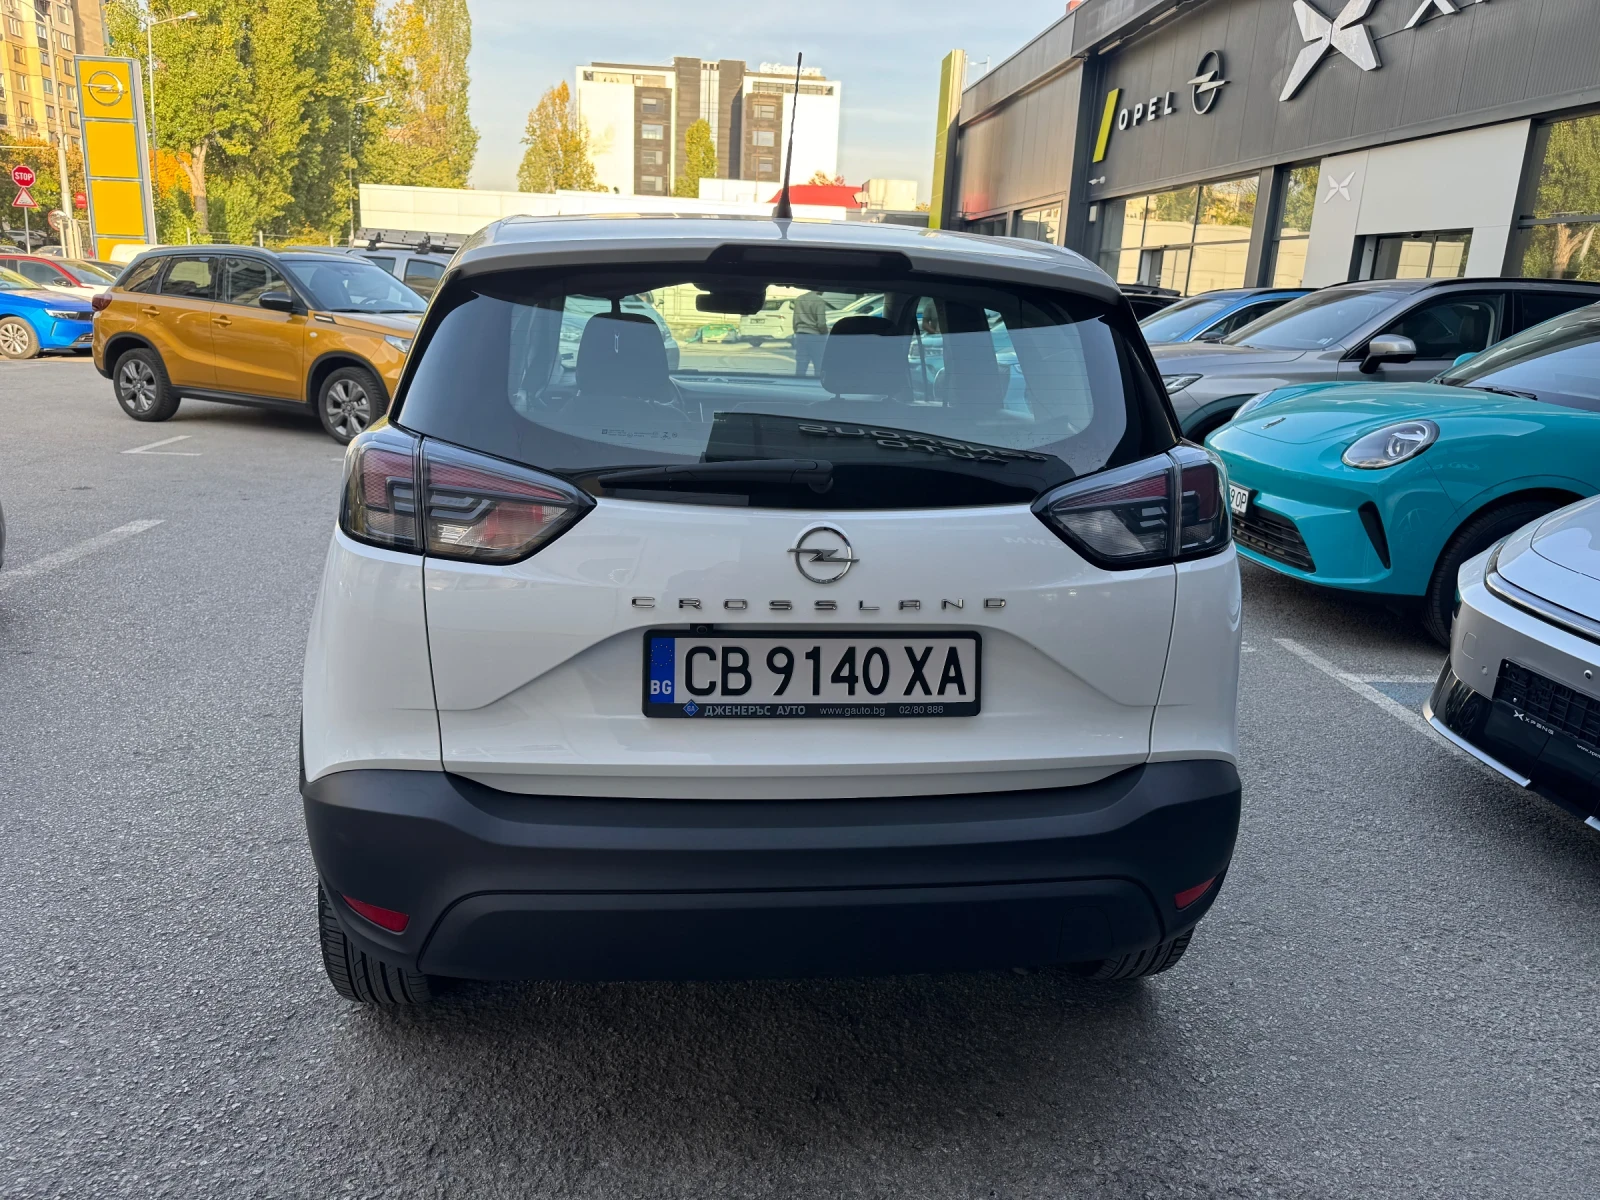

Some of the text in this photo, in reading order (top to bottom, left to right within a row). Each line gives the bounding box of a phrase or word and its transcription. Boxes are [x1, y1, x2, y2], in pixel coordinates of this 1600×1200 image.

[1118, 91, 1173, 131] OPEL
[14, 172, 33, 181] STOP
[631, 596, 1007, 612] CROSSLAND
[685, 645, 967, 696] CB 9140 XA
[650, 679, 672, 695] BG
[704, 705, 944, 716] ДЖЕНЕРЪС АУТО www.gauto.bg 02/80 888
